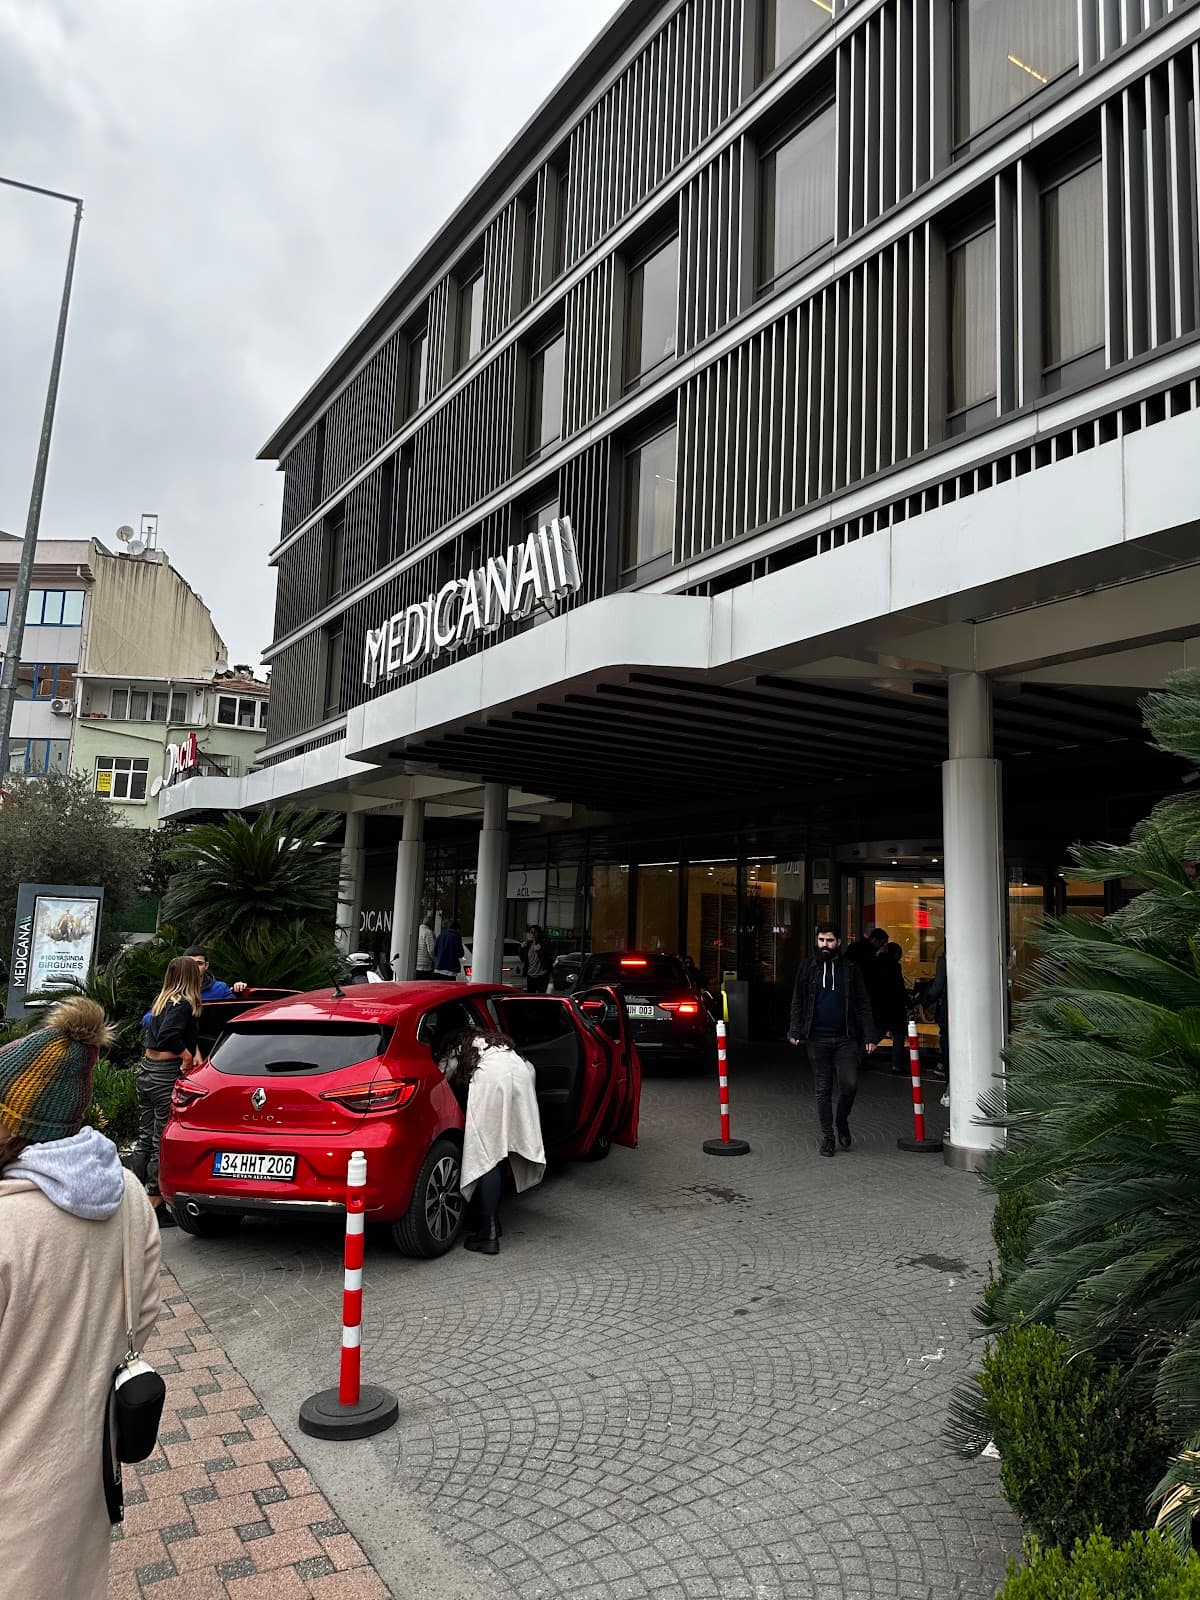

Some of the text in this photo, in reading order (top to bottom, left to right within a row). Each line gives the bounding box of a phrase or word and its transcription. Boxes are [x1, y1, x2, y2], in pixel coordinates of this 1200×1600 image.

[222, 1154, 238, 1170] 34
[240, 1156, 266, 1172] HHT
[267, 1157, 292, 1174] 206
